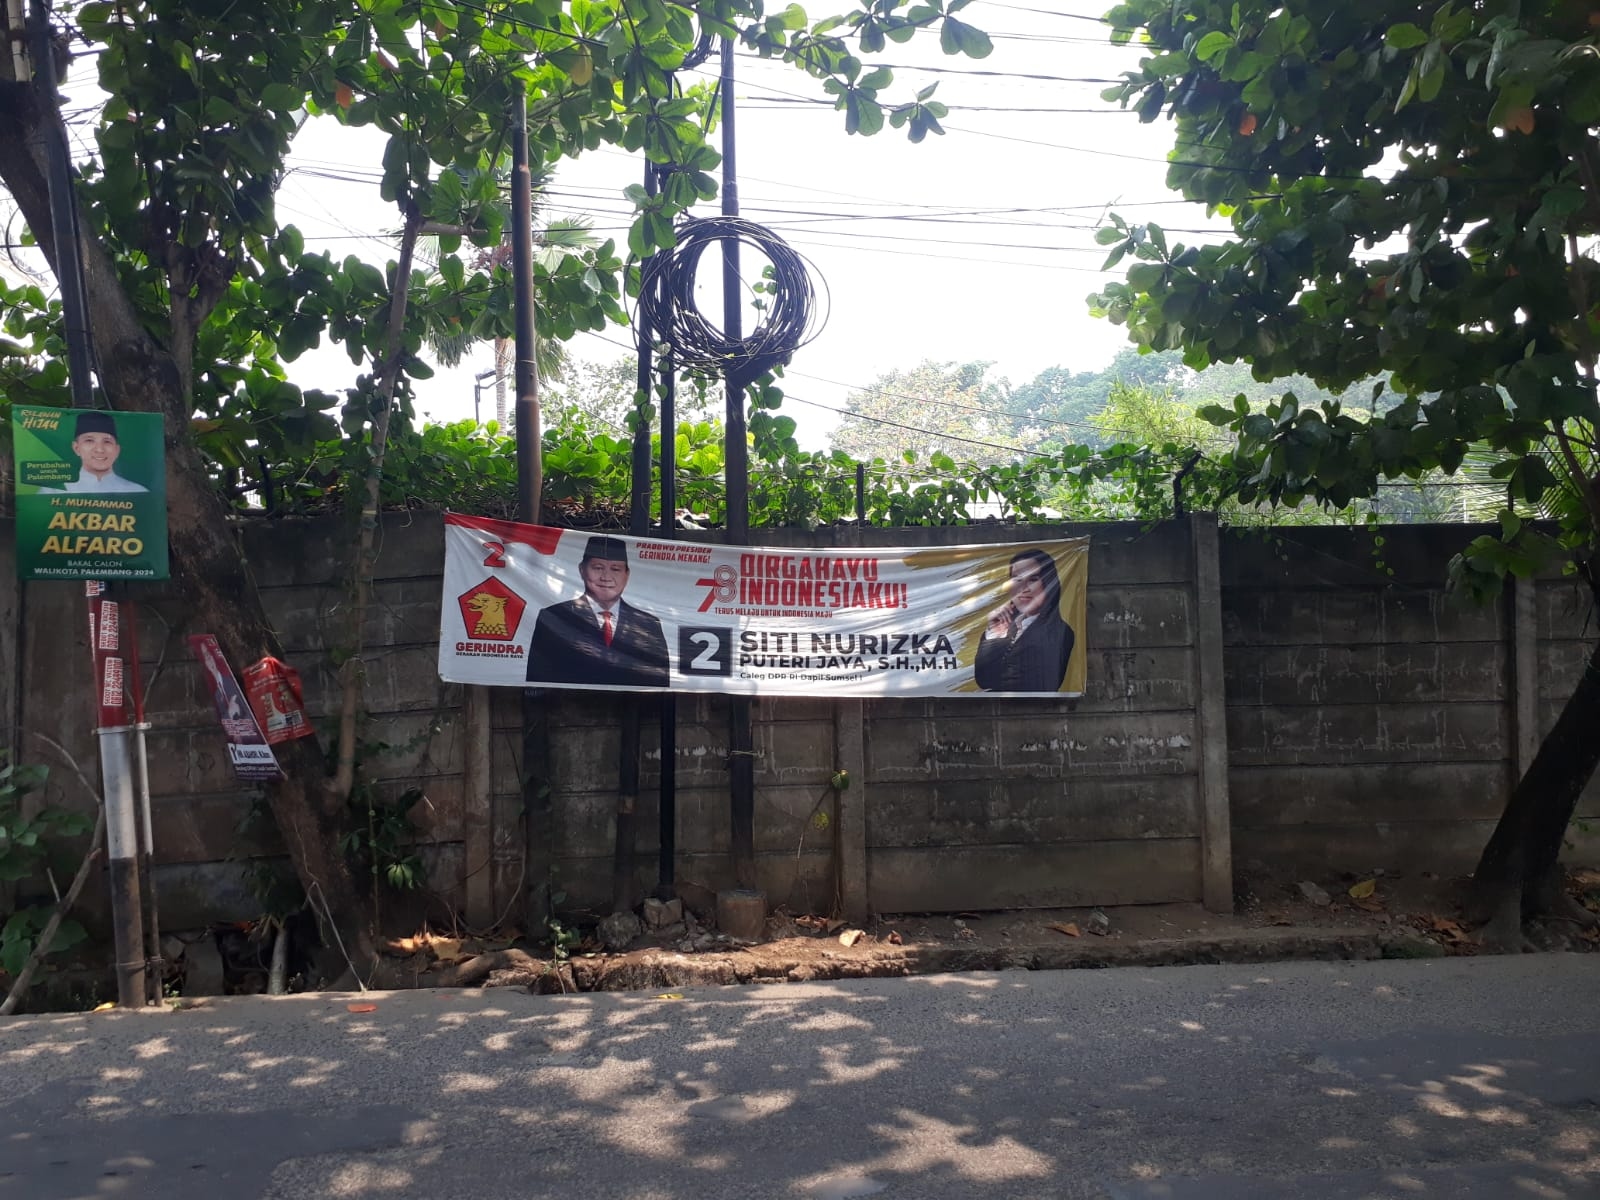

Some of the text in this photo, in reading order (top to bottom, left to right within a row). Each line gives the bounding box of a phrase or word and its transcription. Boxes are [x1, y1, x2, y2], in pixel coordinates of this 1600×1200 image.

[51, 498, 133, 509] H. MUHAMMAD
[48, 512, 136, 532] AKBAR
[41, 536, 144, 555] ALFARO
[636, 542, 712, 553] PRABOWO PRESIDEN
[482, 542, 506, 568] 2
[639, 551, 710, 564] GERINDRA MENANG!
[80, 568, 131, 576] PALEMBANG
[740, 553, 879, 582] DIRGAHAYU
[696, 564, 738, 612] 78
[739, 578, 908, 609] INDONESIAKU!
[715, 607, 833, 618] TERUS MELAJU UNTUK INDONESIA MAJU
[456, 642, 524, 654] GERINDRA
[690, 632, 721, 670] 2
[740, 630, 954, 655] SITI NURIZKA
[740, 655, 810, 669] PUTERI
[817, 656, 872, 672] JAYA,
[740, 672, 765, 680] Caleg
[801, 673, 823, 682] Dapil
